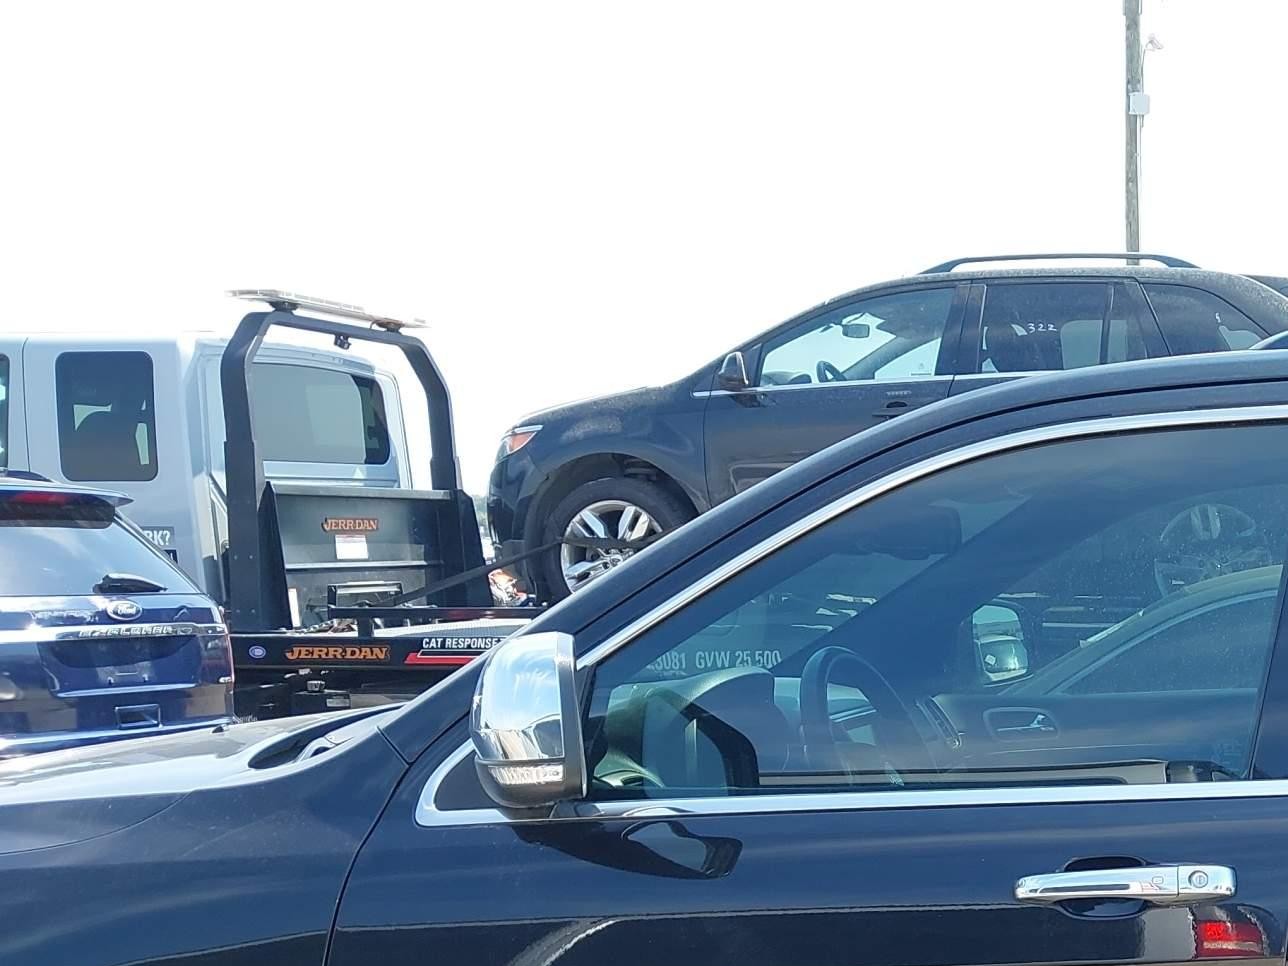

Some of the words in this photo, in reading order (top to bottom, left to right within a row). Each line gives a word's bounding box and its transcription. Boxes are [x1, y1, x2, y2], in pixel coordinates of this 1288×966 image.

[1027, 322, 1057, 334] 322
[422, 638, 443, 649] CAT
[445, 638, 499, 649] RESPONSE
[695, 650, 730, 669] GVW
